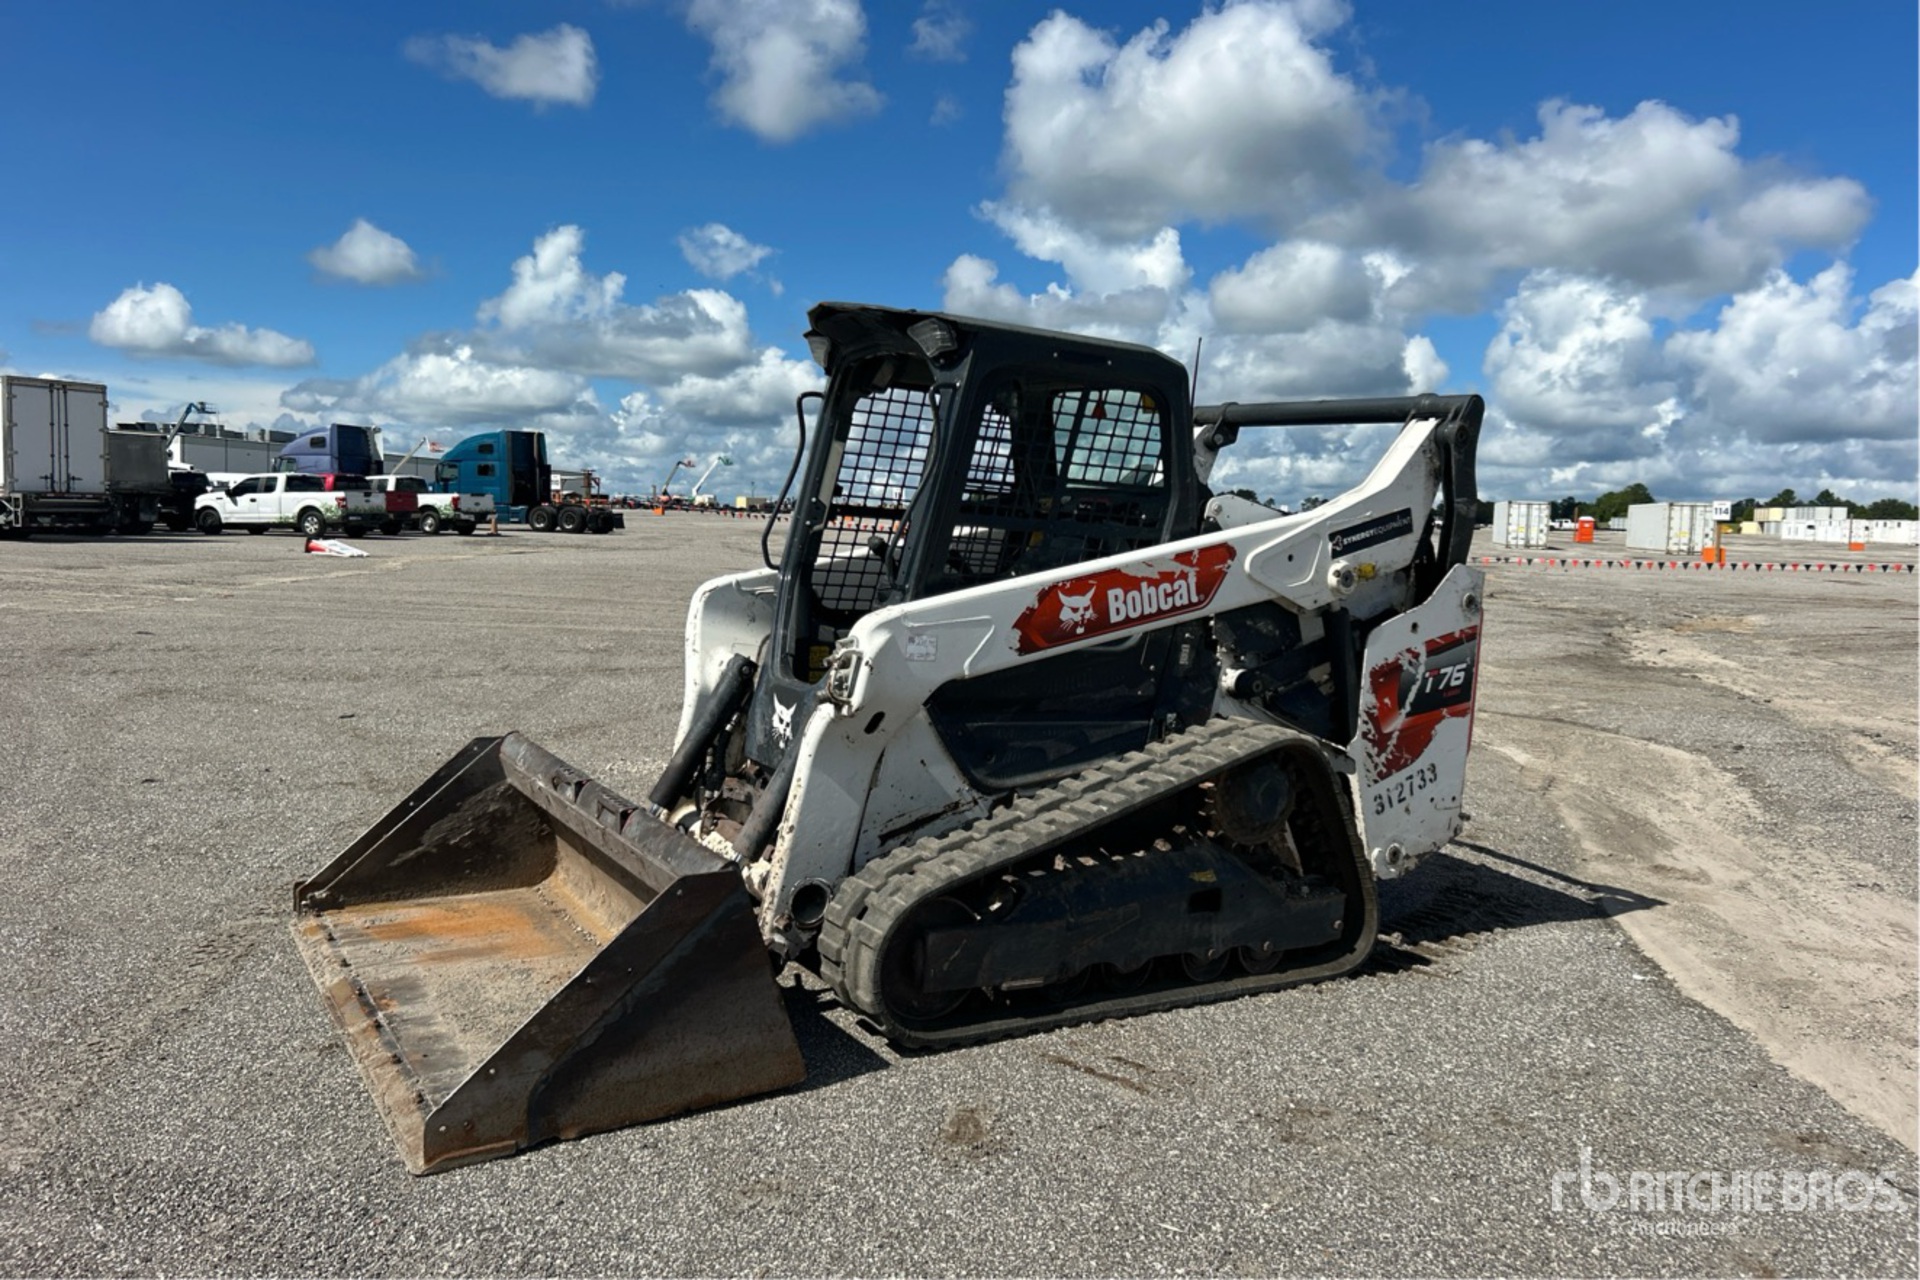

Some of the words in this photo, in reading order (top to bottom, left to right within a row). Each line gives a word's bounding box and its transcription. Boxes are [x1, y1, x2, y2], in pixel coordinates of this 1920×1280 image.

[1714, 507, 1729, 516] 114
[1107, 571, 1199, 624] Bobcat
[1373, 762, 1438, 816] 312733
